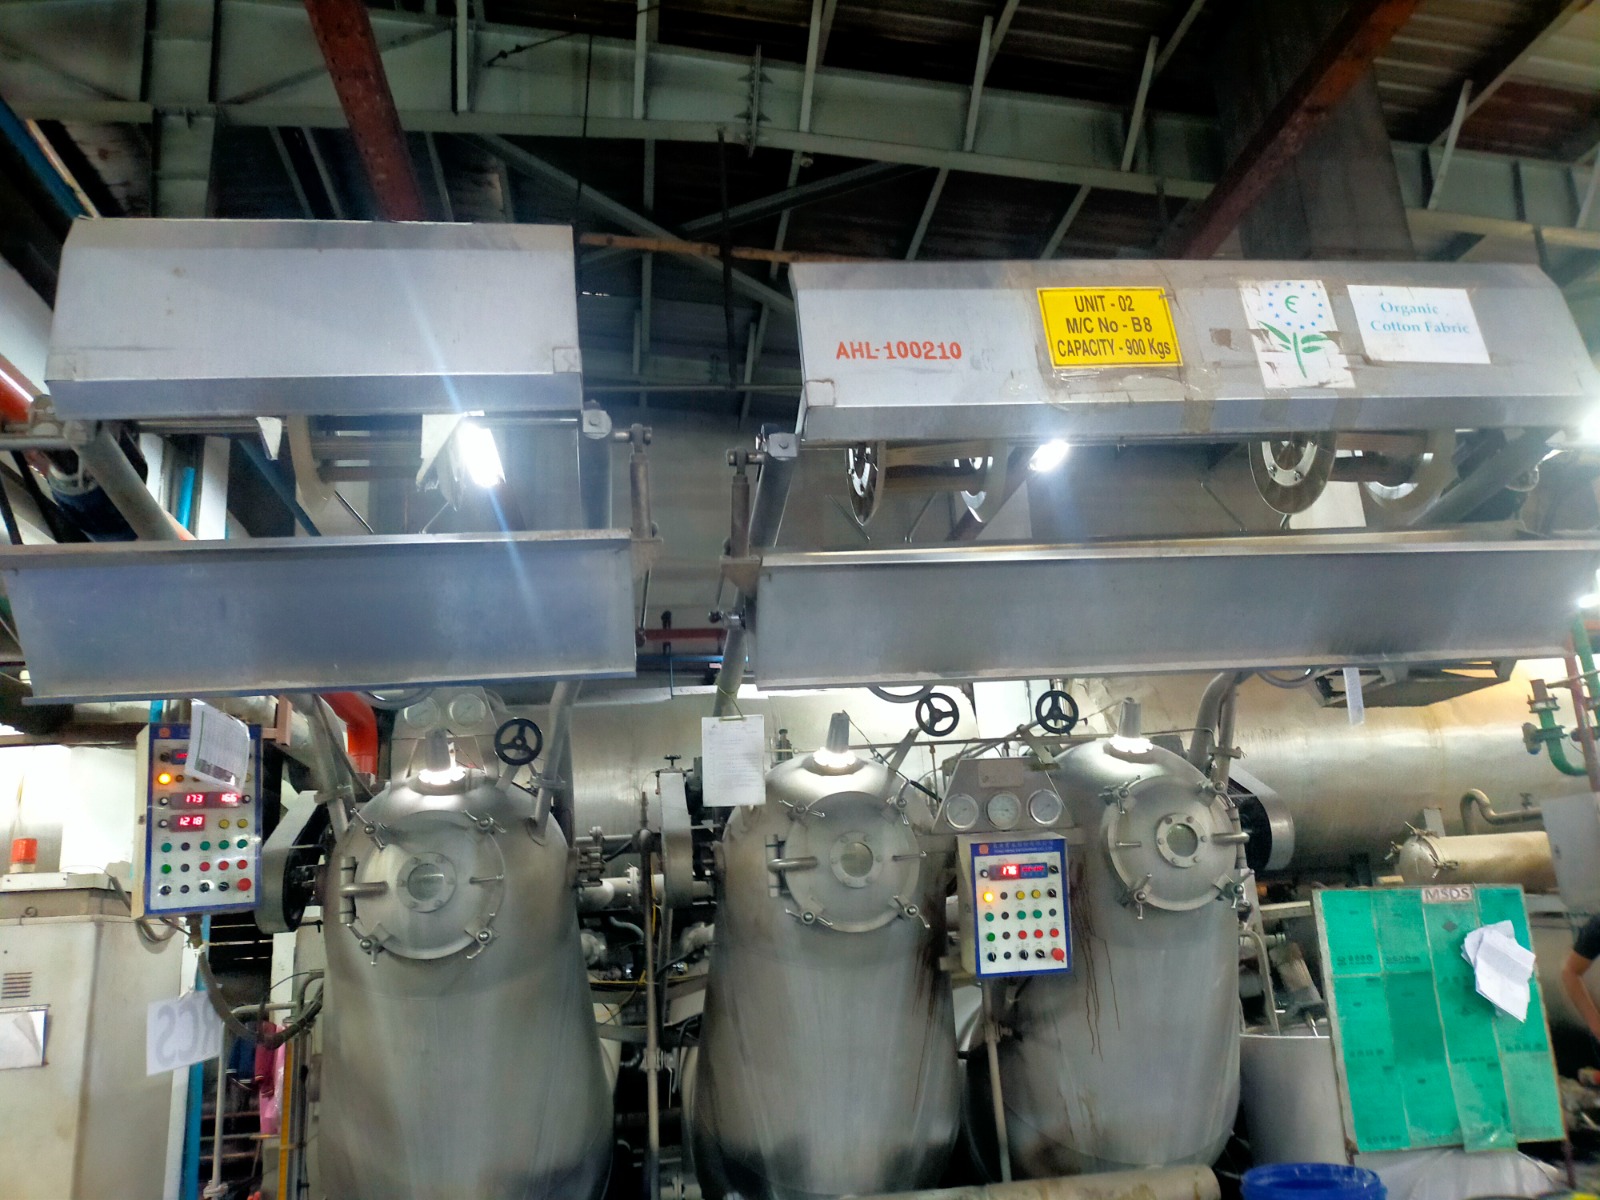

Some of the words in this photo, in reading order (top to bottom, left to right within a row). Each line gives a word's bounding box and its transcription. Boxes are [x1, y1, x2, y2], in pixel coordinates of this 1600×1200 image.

[1074, 295, 1105, 312] UNIT
[1118, 295, 1134, 312] 02
[1380, 302, 1438, 317] Organic
[1066, 317, 1094, 334] M/C
[1098, 317, 1118, 333] No
[1370, 320, 1420, 332] Cotton
[1425, 321, 1469, 333] Fabric
[836, 341, 962, 360] AHL-100210
[1057, 338, 1114, 357] CAPACITY
[1125, 338, 1146, 355] 900
[1147, 338, 1171, 359] Kgs
